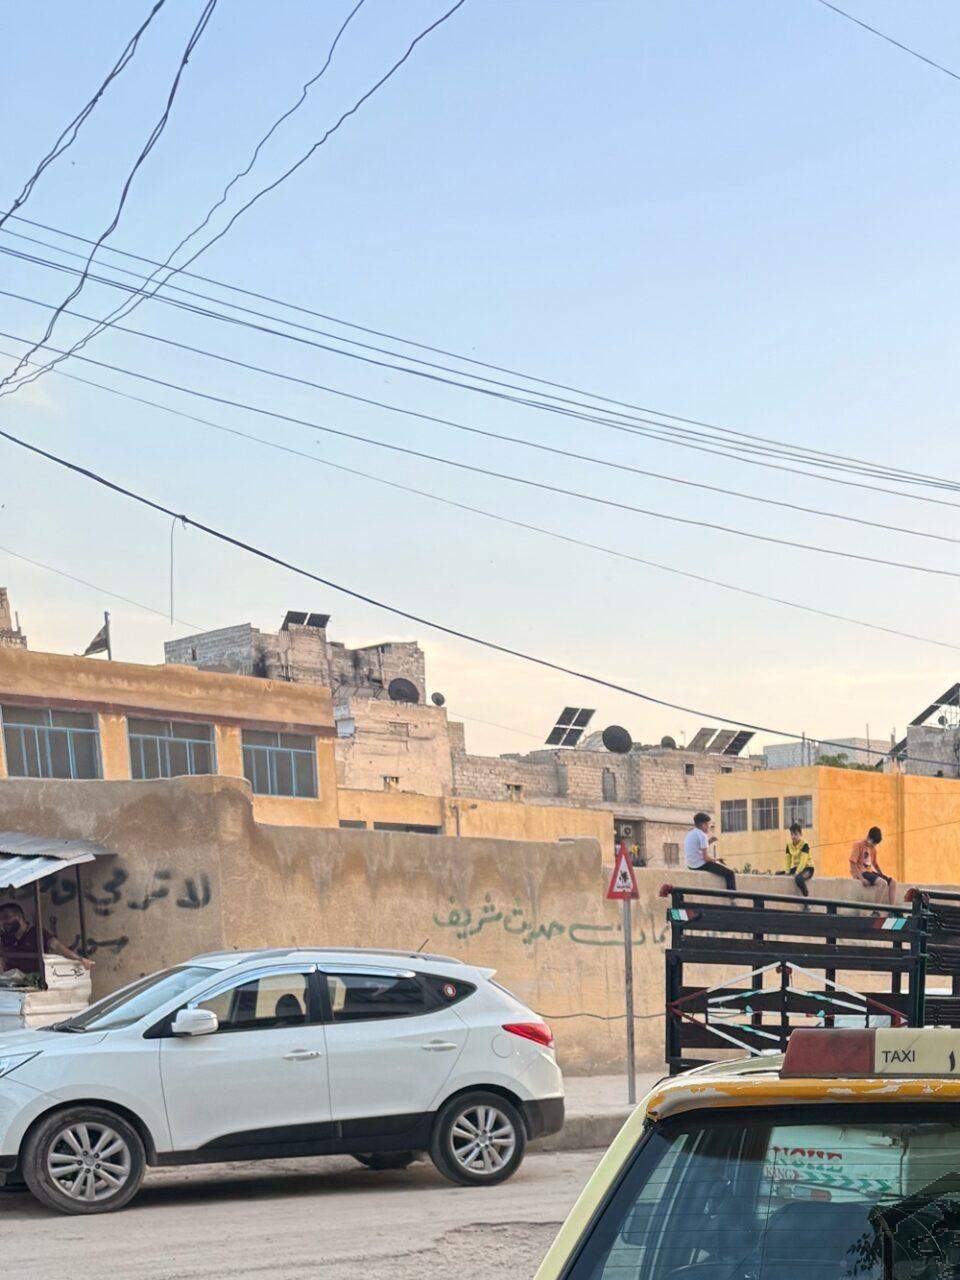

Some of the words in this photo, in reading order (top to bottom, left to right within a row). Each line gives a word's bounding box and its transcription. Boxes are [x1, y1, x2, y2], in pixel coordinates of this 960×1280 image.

[176, 872, 212, 909] لا
[432, 891, 504, 941] شريف
[882, 1050, 916, 1063] TAXI
